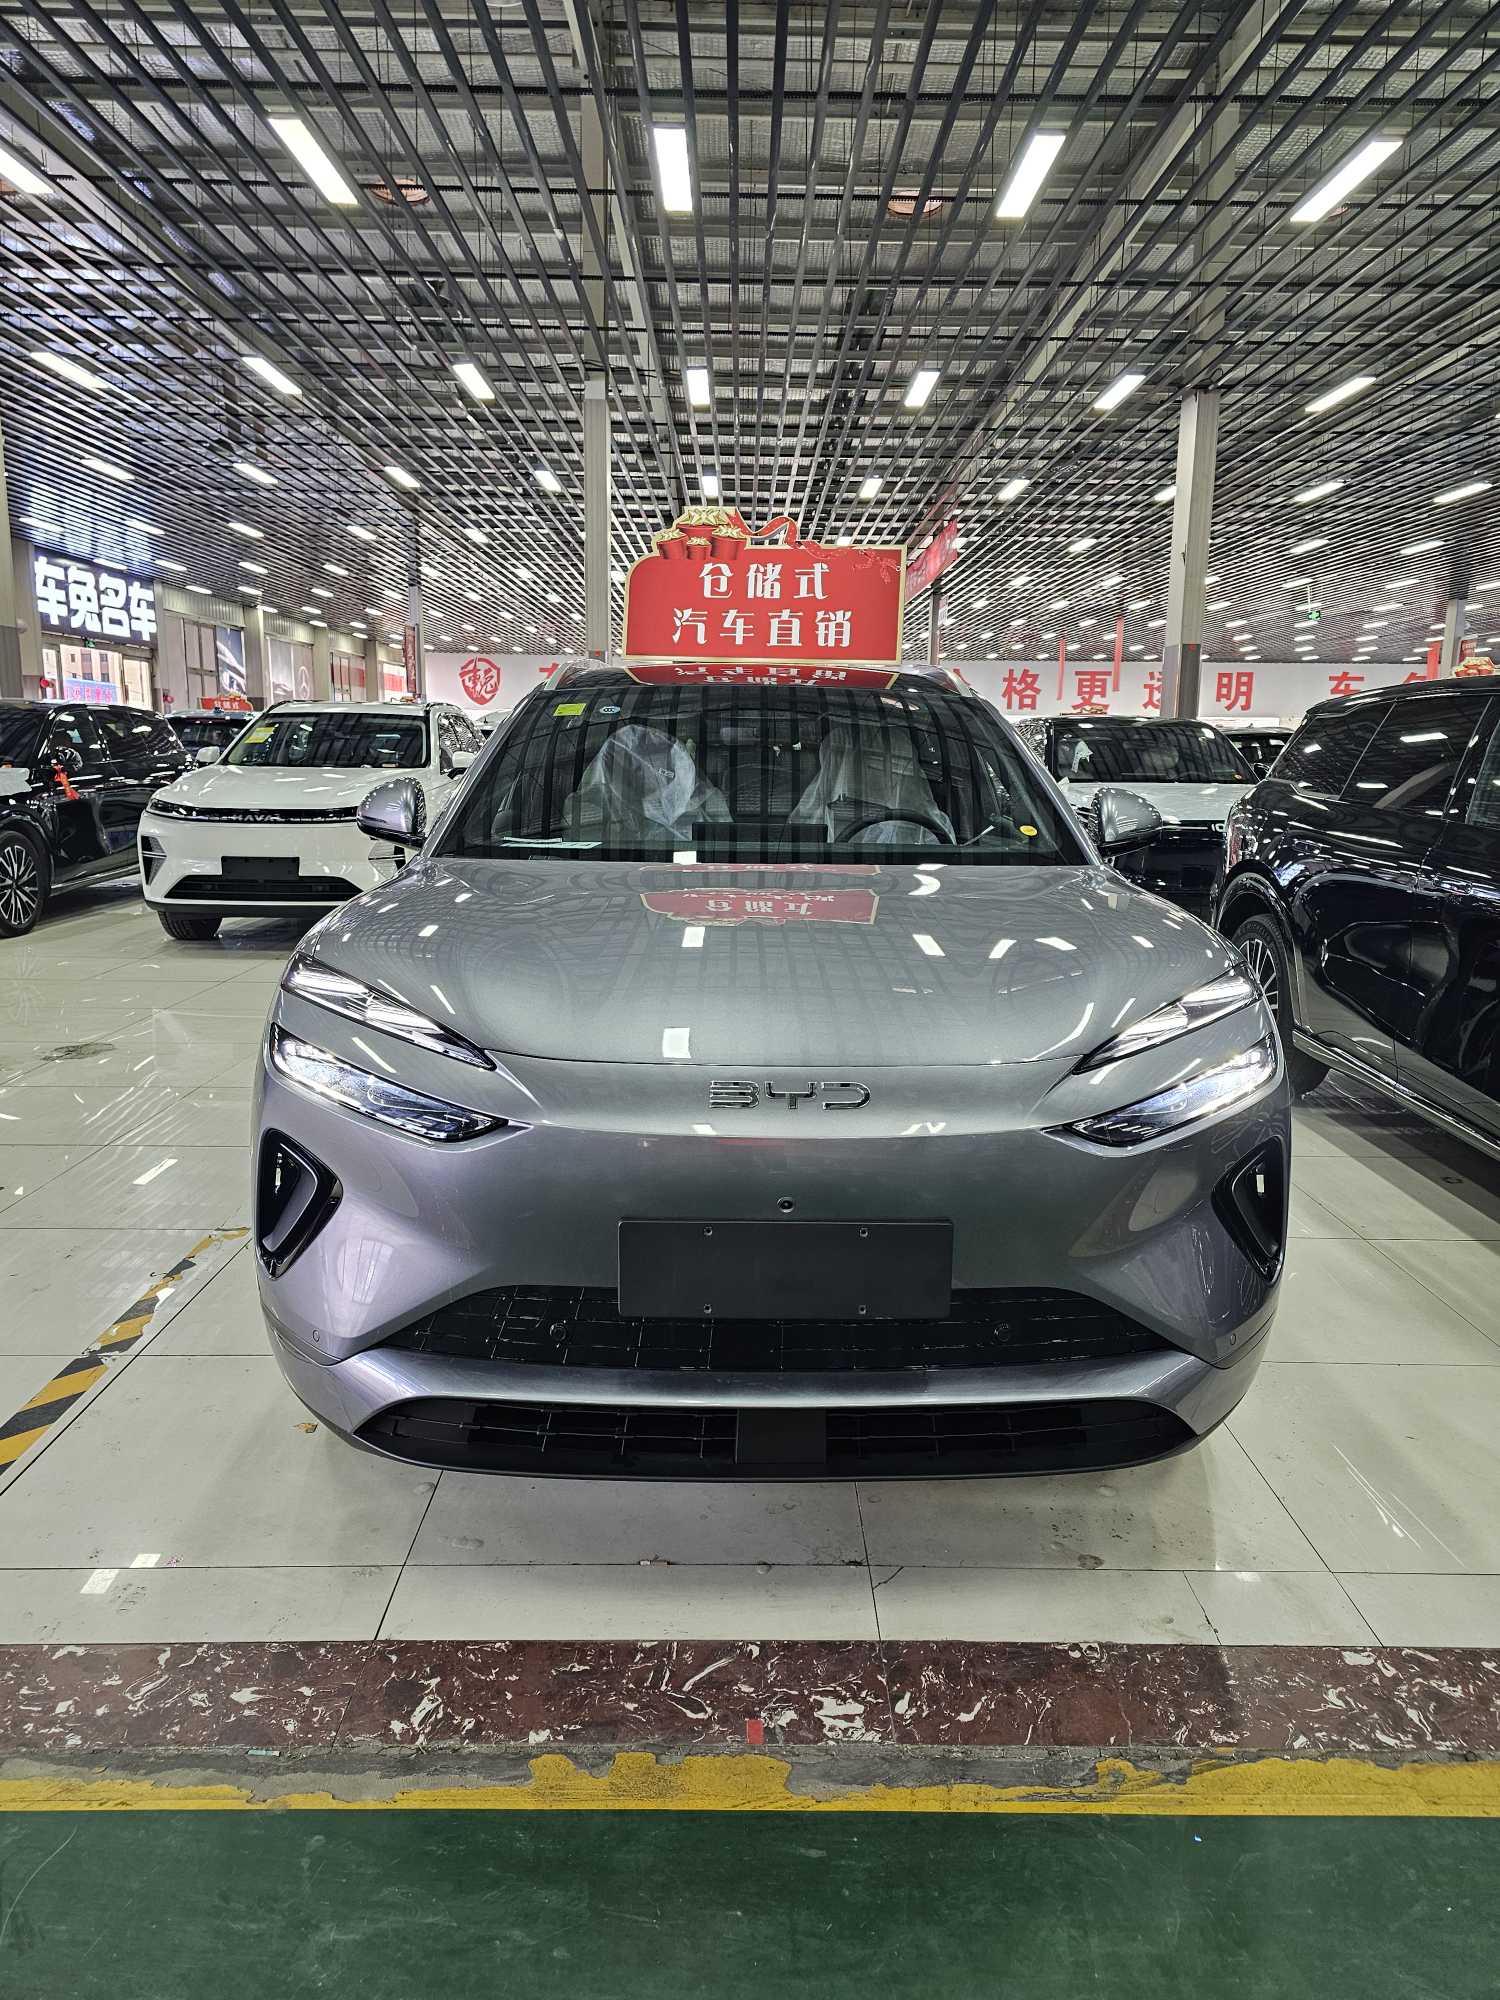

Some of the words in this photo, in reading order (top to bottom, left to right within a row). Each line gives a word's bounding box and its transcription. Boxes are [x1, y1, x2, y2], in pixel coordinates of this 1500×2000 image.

[34, 556, 157, 641] 车兔名车
[699, 562, 831, 600] 仓储式
[672, 607, 852, 647] 汽车直销
[709, 1080, 871, 1110] BYD
